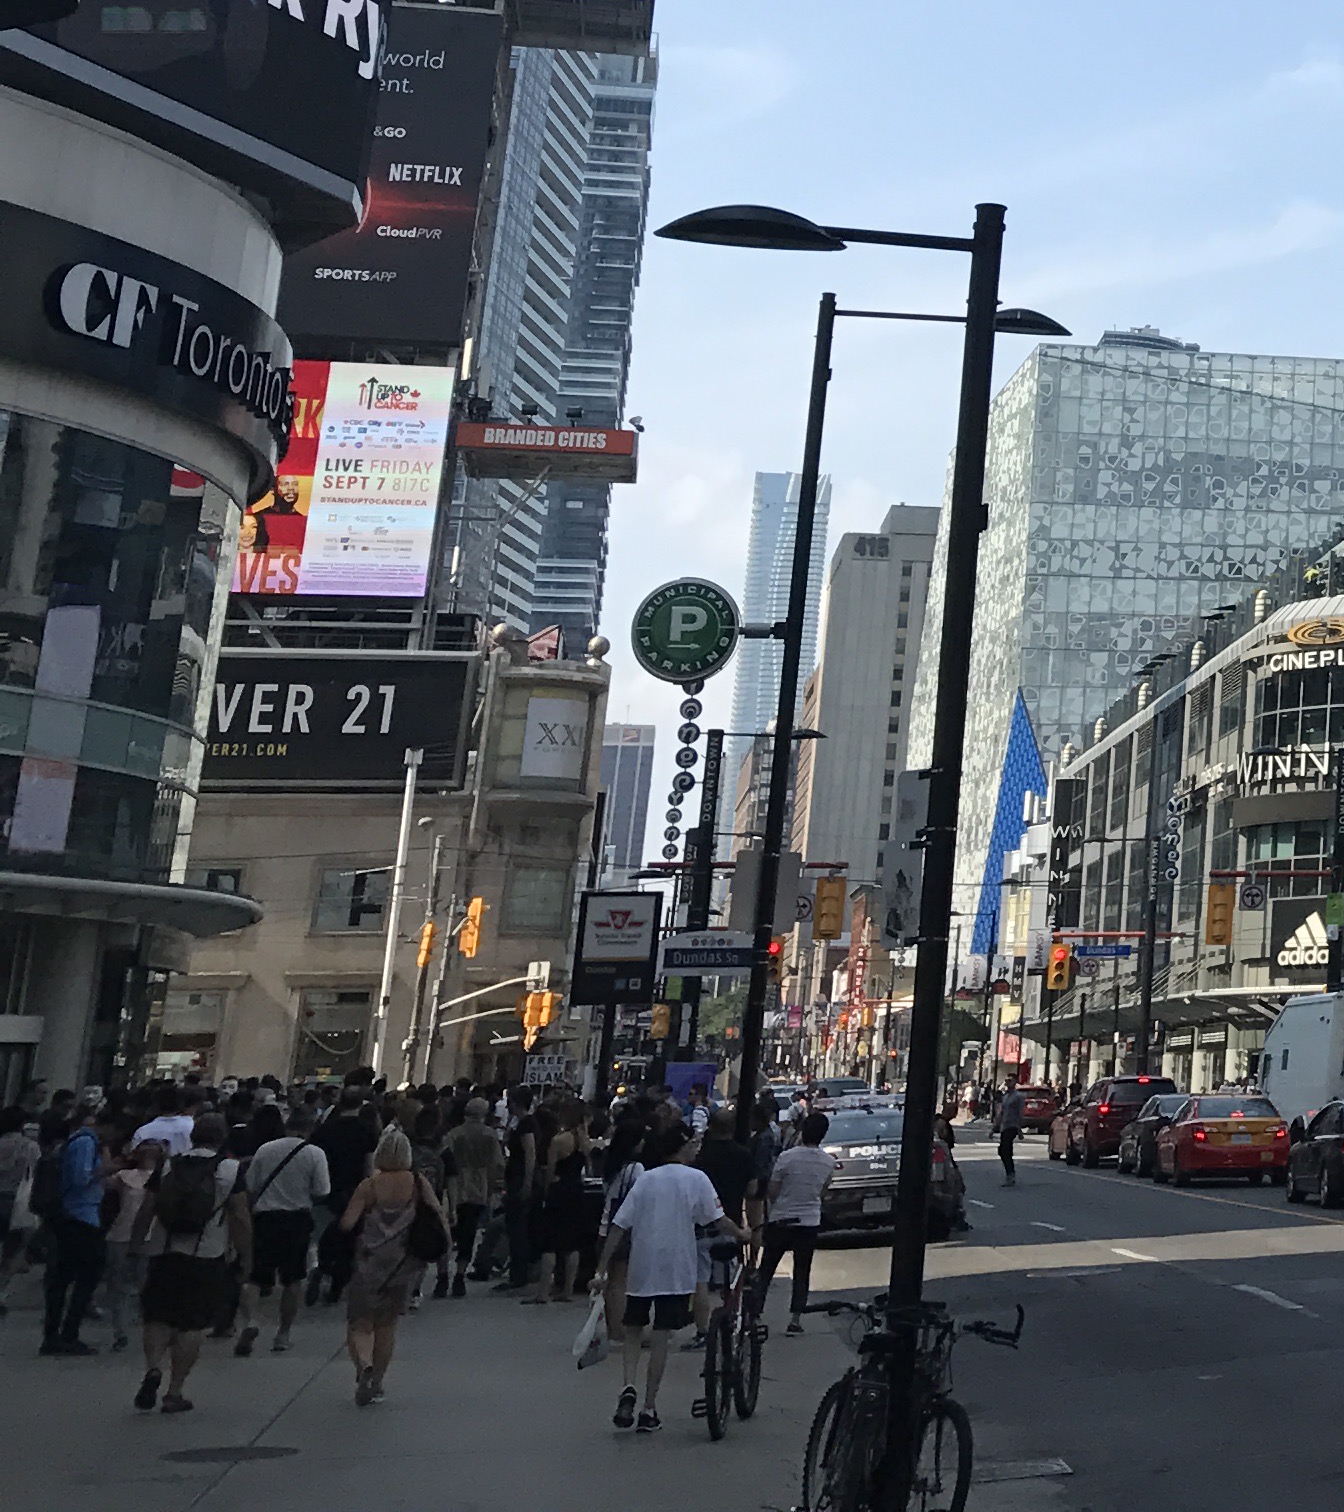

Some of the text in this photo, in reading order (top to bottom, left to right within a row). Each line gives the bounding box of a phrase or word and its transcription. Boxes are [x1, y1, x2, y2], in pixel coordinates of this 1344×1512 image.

[383, 49, 445, 70] world
[373, 125, 406, 138] &GO
[388, 162, 463, 186] NETFLIX
[376, 225, 442, 239] CloudPVR
[60, 262, 283, 420] CF Toronto
[376, 384, 410, 395] STAND
[373, 399, 418, 411] CANCER
[483, 427, 607, 449] BRANDED CITIES
[324, 458, 435, 476] LIVE FRIDAY
[322, 475, 431, 493] SEPT 7 8|7C
[320, 496, 427, 507] STANDUPTOCANCER.CA
[853, 536, 890, 557] 415
[643, 586, 730, 620] MUNICIPAL
[669, 605, 709, 642] P
[640, 636, 731, 672] PARKING
[214, 681, 397, 735] VER 21
[702, 734, 721, 823] DOWNTOWN
[672, 950, 740, 966] Dundas Sq
[1277, 945, 1330, 967] adida
[1014, 964, 1024, 999] HMV
[528, 1055, 565, 1065] FREE
[525, 1071, 563, 1083] ISLAM
